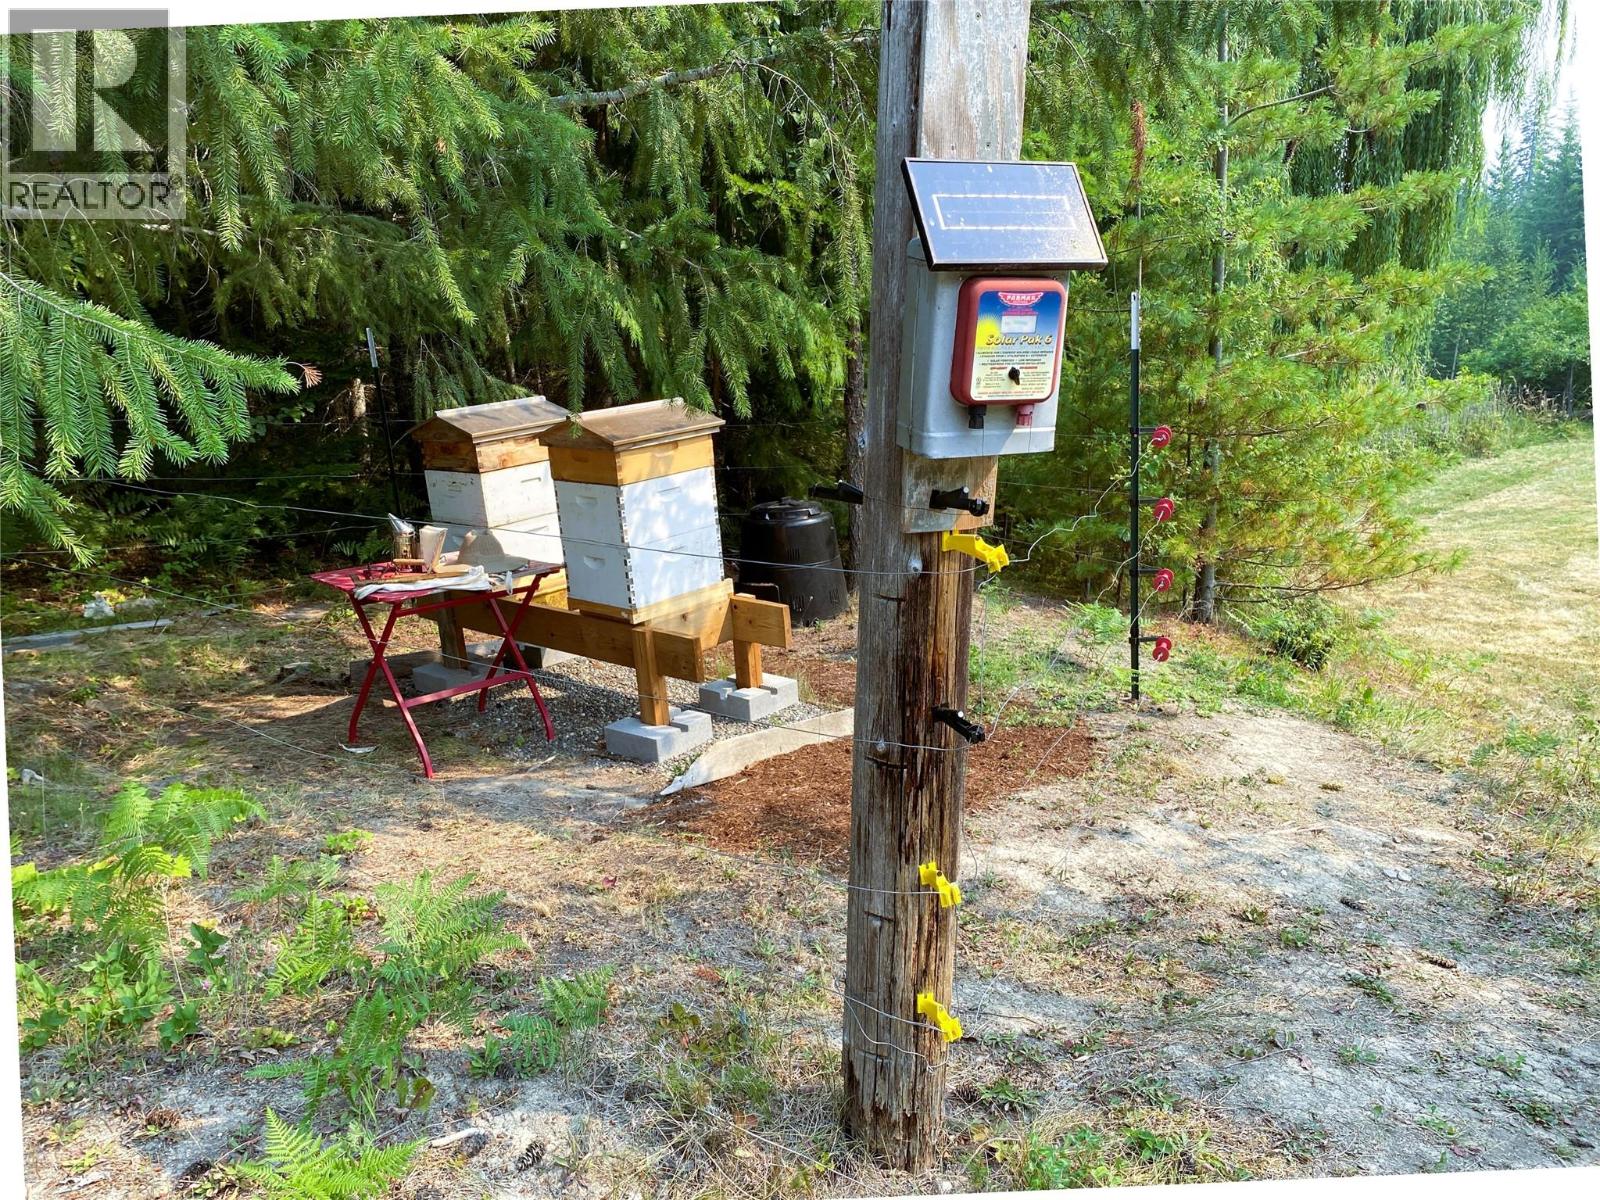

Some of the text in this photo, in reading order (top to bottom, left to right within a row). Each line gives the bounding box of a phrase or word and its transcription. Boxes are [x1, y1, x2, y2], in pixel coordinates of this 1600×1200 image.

[986, 334, 1053, 346] Solar Pak 6
